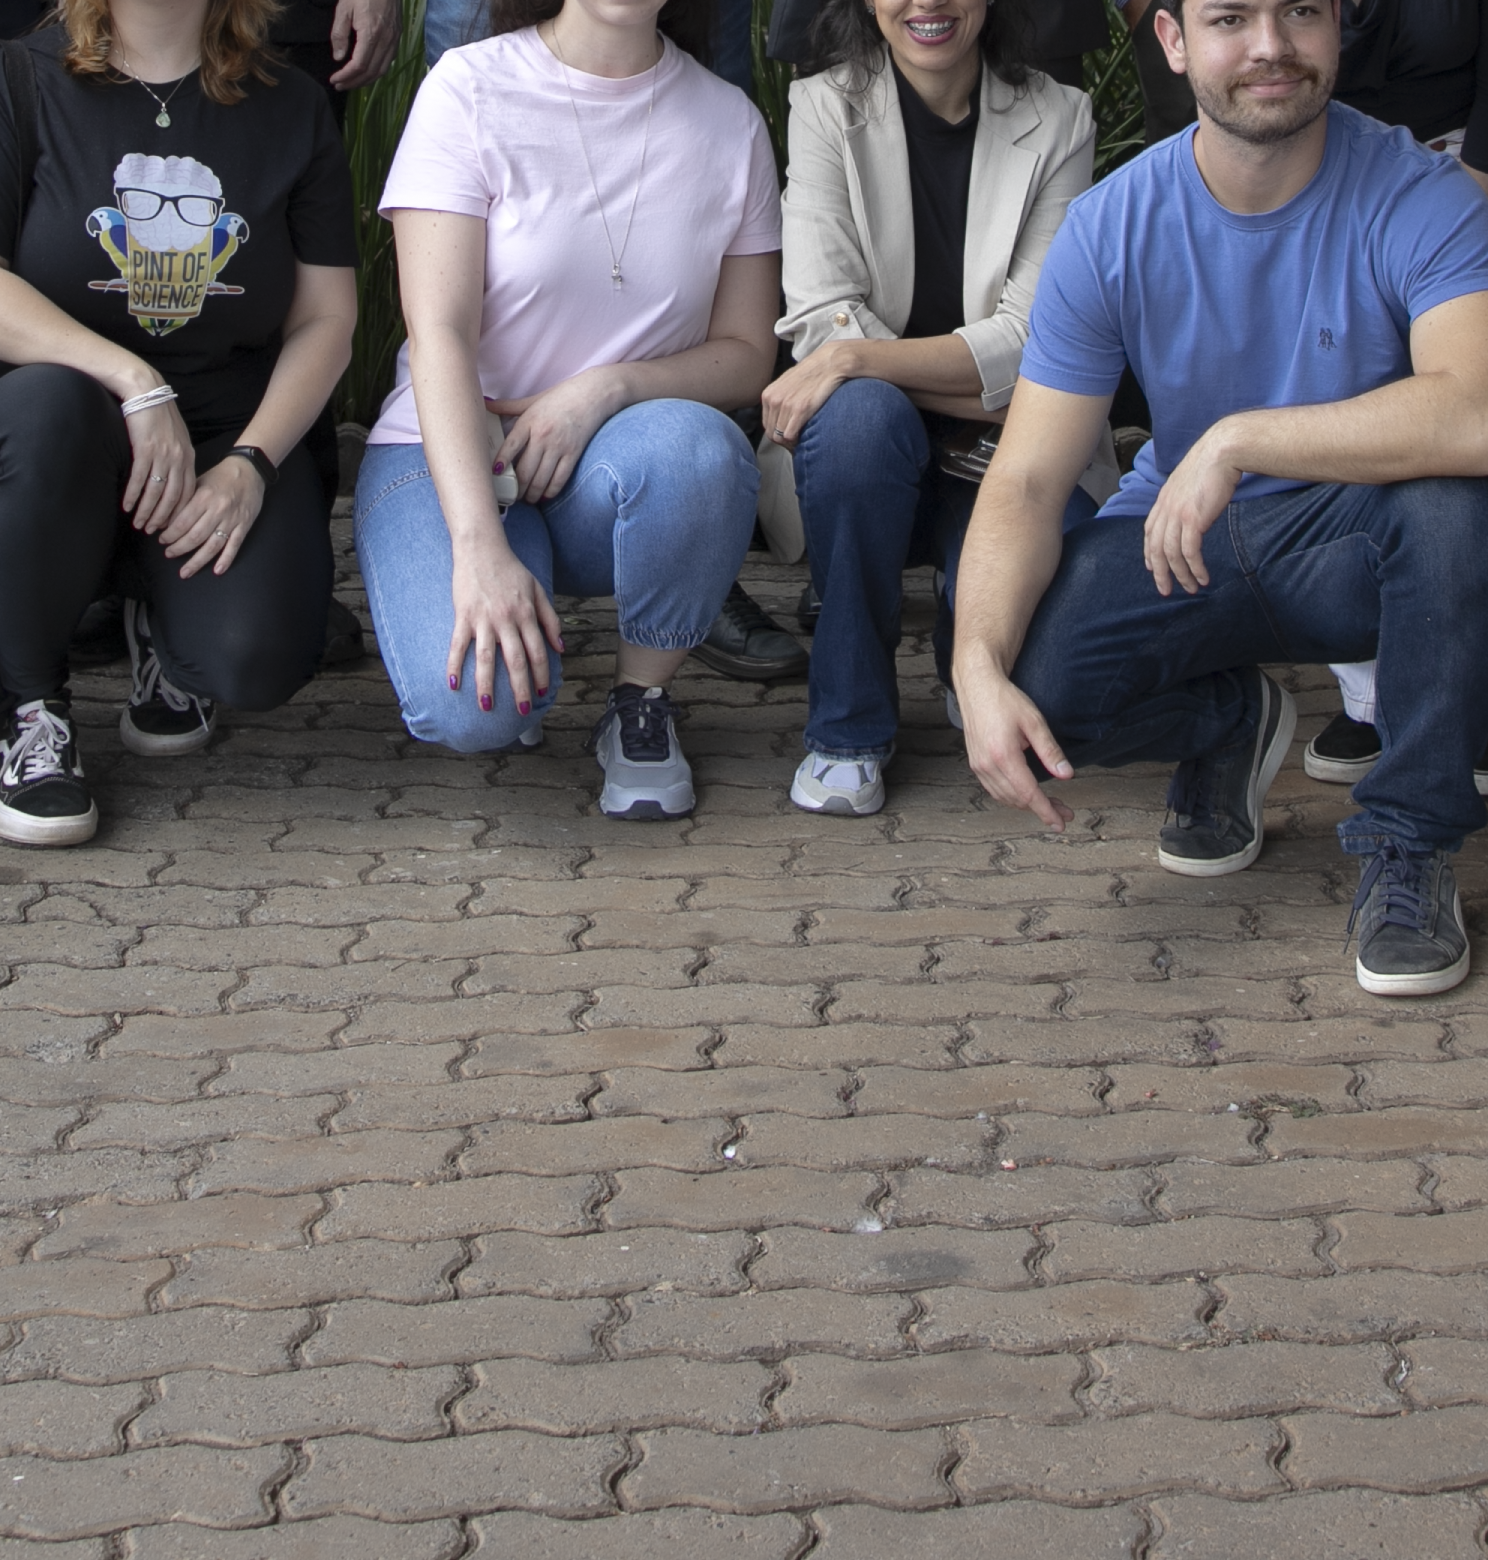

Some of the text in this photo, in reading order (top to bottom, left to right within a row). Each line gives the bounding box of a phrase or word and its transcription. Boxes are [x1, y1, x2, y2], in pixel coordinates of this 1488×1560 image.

[133, 250, 207, 283] PINT OF
[132, 281, 203, 309] SCIENCE
